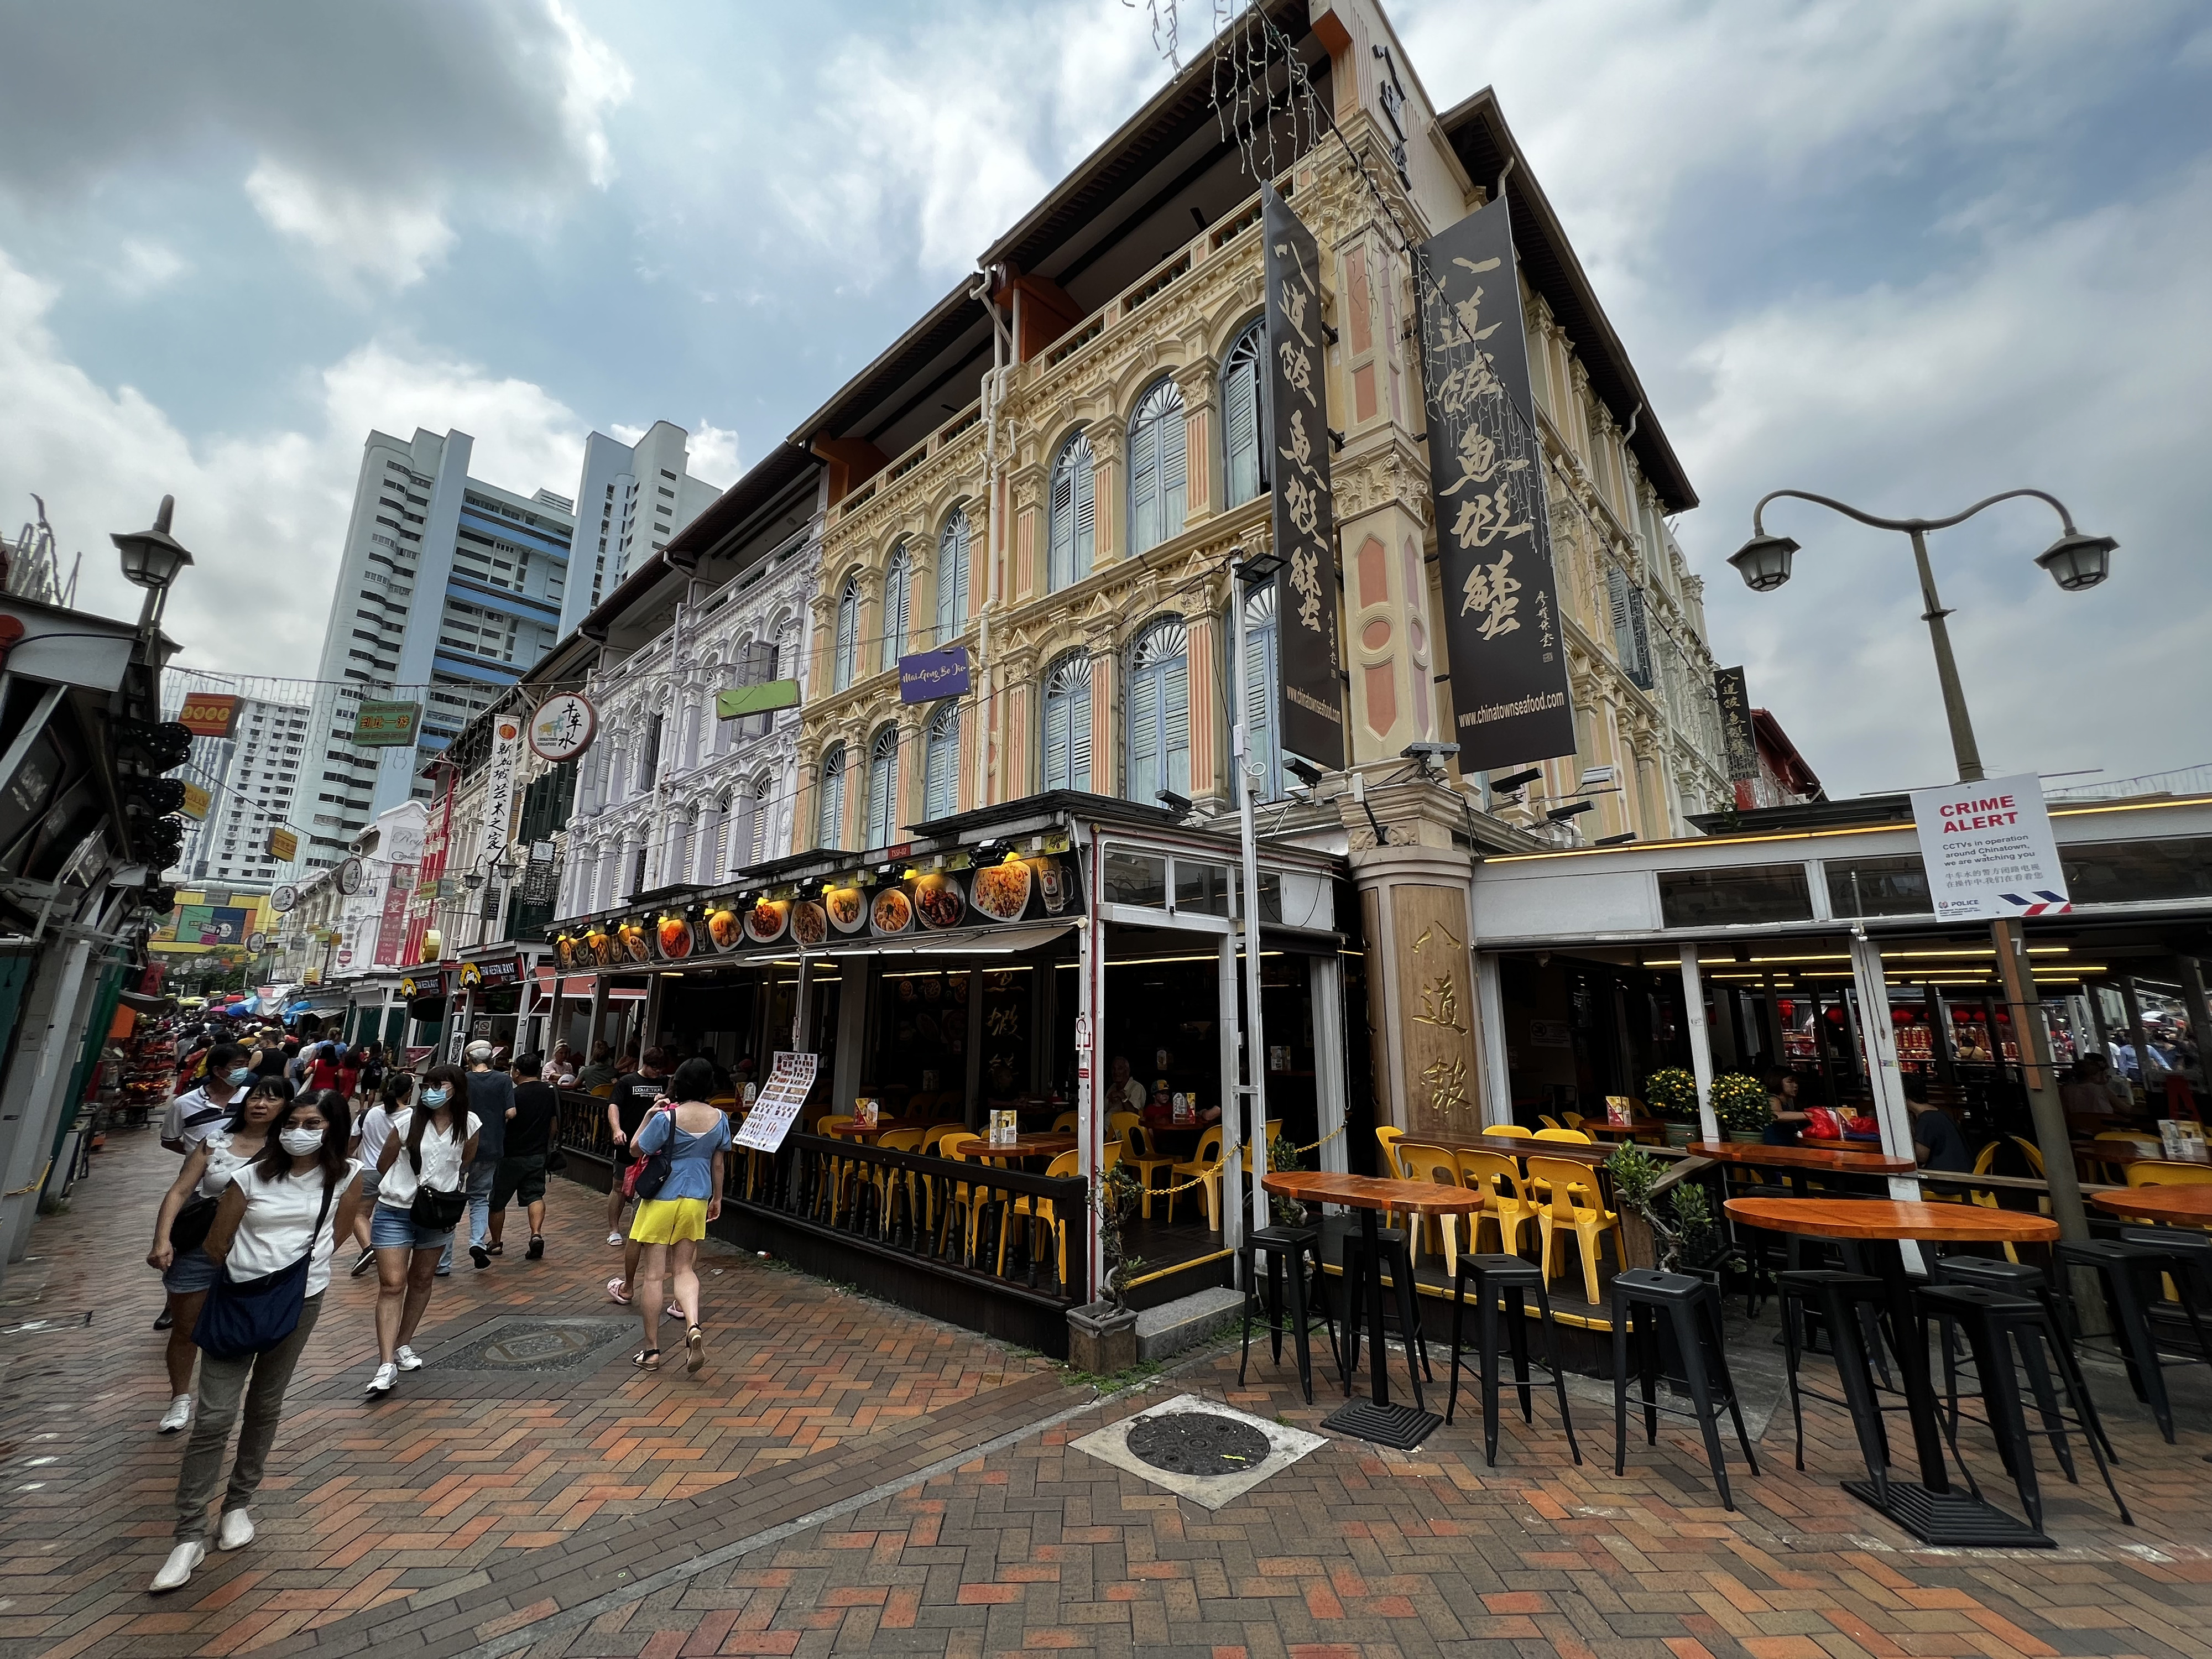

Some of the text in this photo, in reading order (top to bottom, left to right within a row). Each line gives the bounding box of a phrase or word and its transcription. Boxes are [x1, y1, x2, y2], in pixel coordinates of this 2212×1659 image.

[901, 673, 917, 683] Mai
[918, 670, 940, 682] Gong
[941, 666, 951, 677] Bo
[1286, 685, 1340, 724] www.chinatownseafood.com
[1458, 691, 1564, 728] www.chinatownseafood.com
[359, 715, 410, 729] 到此一游
[559, 700, 582, 750] 牛车水
[1940, 795, 2015, 817] CRIME
[1943, 811, 2018, 833] ALERT
[1943, 841, 1972, 850] CCTVs
[1985, 835, 2028, 845] operation
[1946, 849, 1976, 858] around
[1974, 854, 2015, 863] watching
